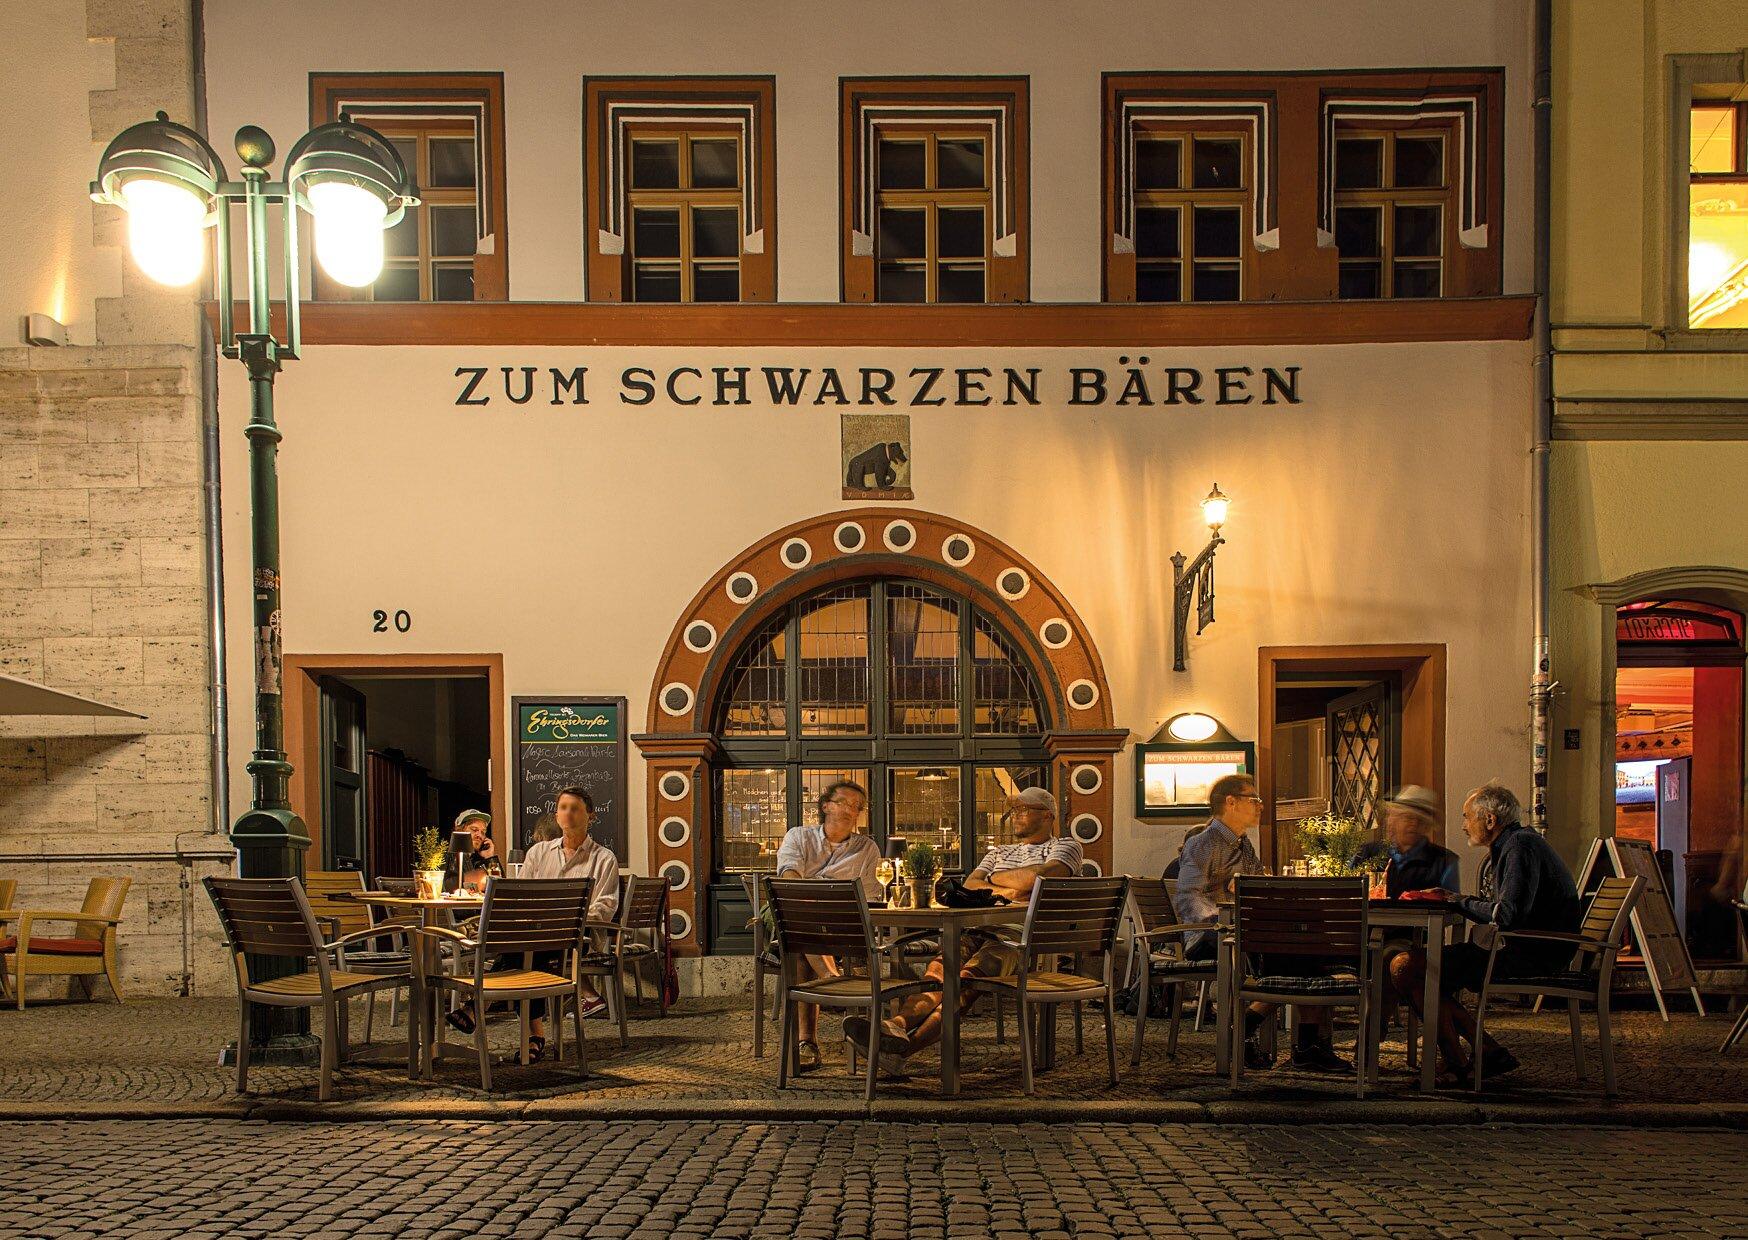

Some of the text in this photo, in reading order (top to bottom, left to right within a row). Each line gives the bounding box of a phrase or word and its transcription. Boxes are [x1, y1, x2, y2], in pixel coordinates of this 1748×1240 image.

[454, 355, 1303, 406] ZUM SCHWARZEN BÄREN
[373, 609, 411, 633] 20
[527, 709, 609, 740] Ehringsdorfer
